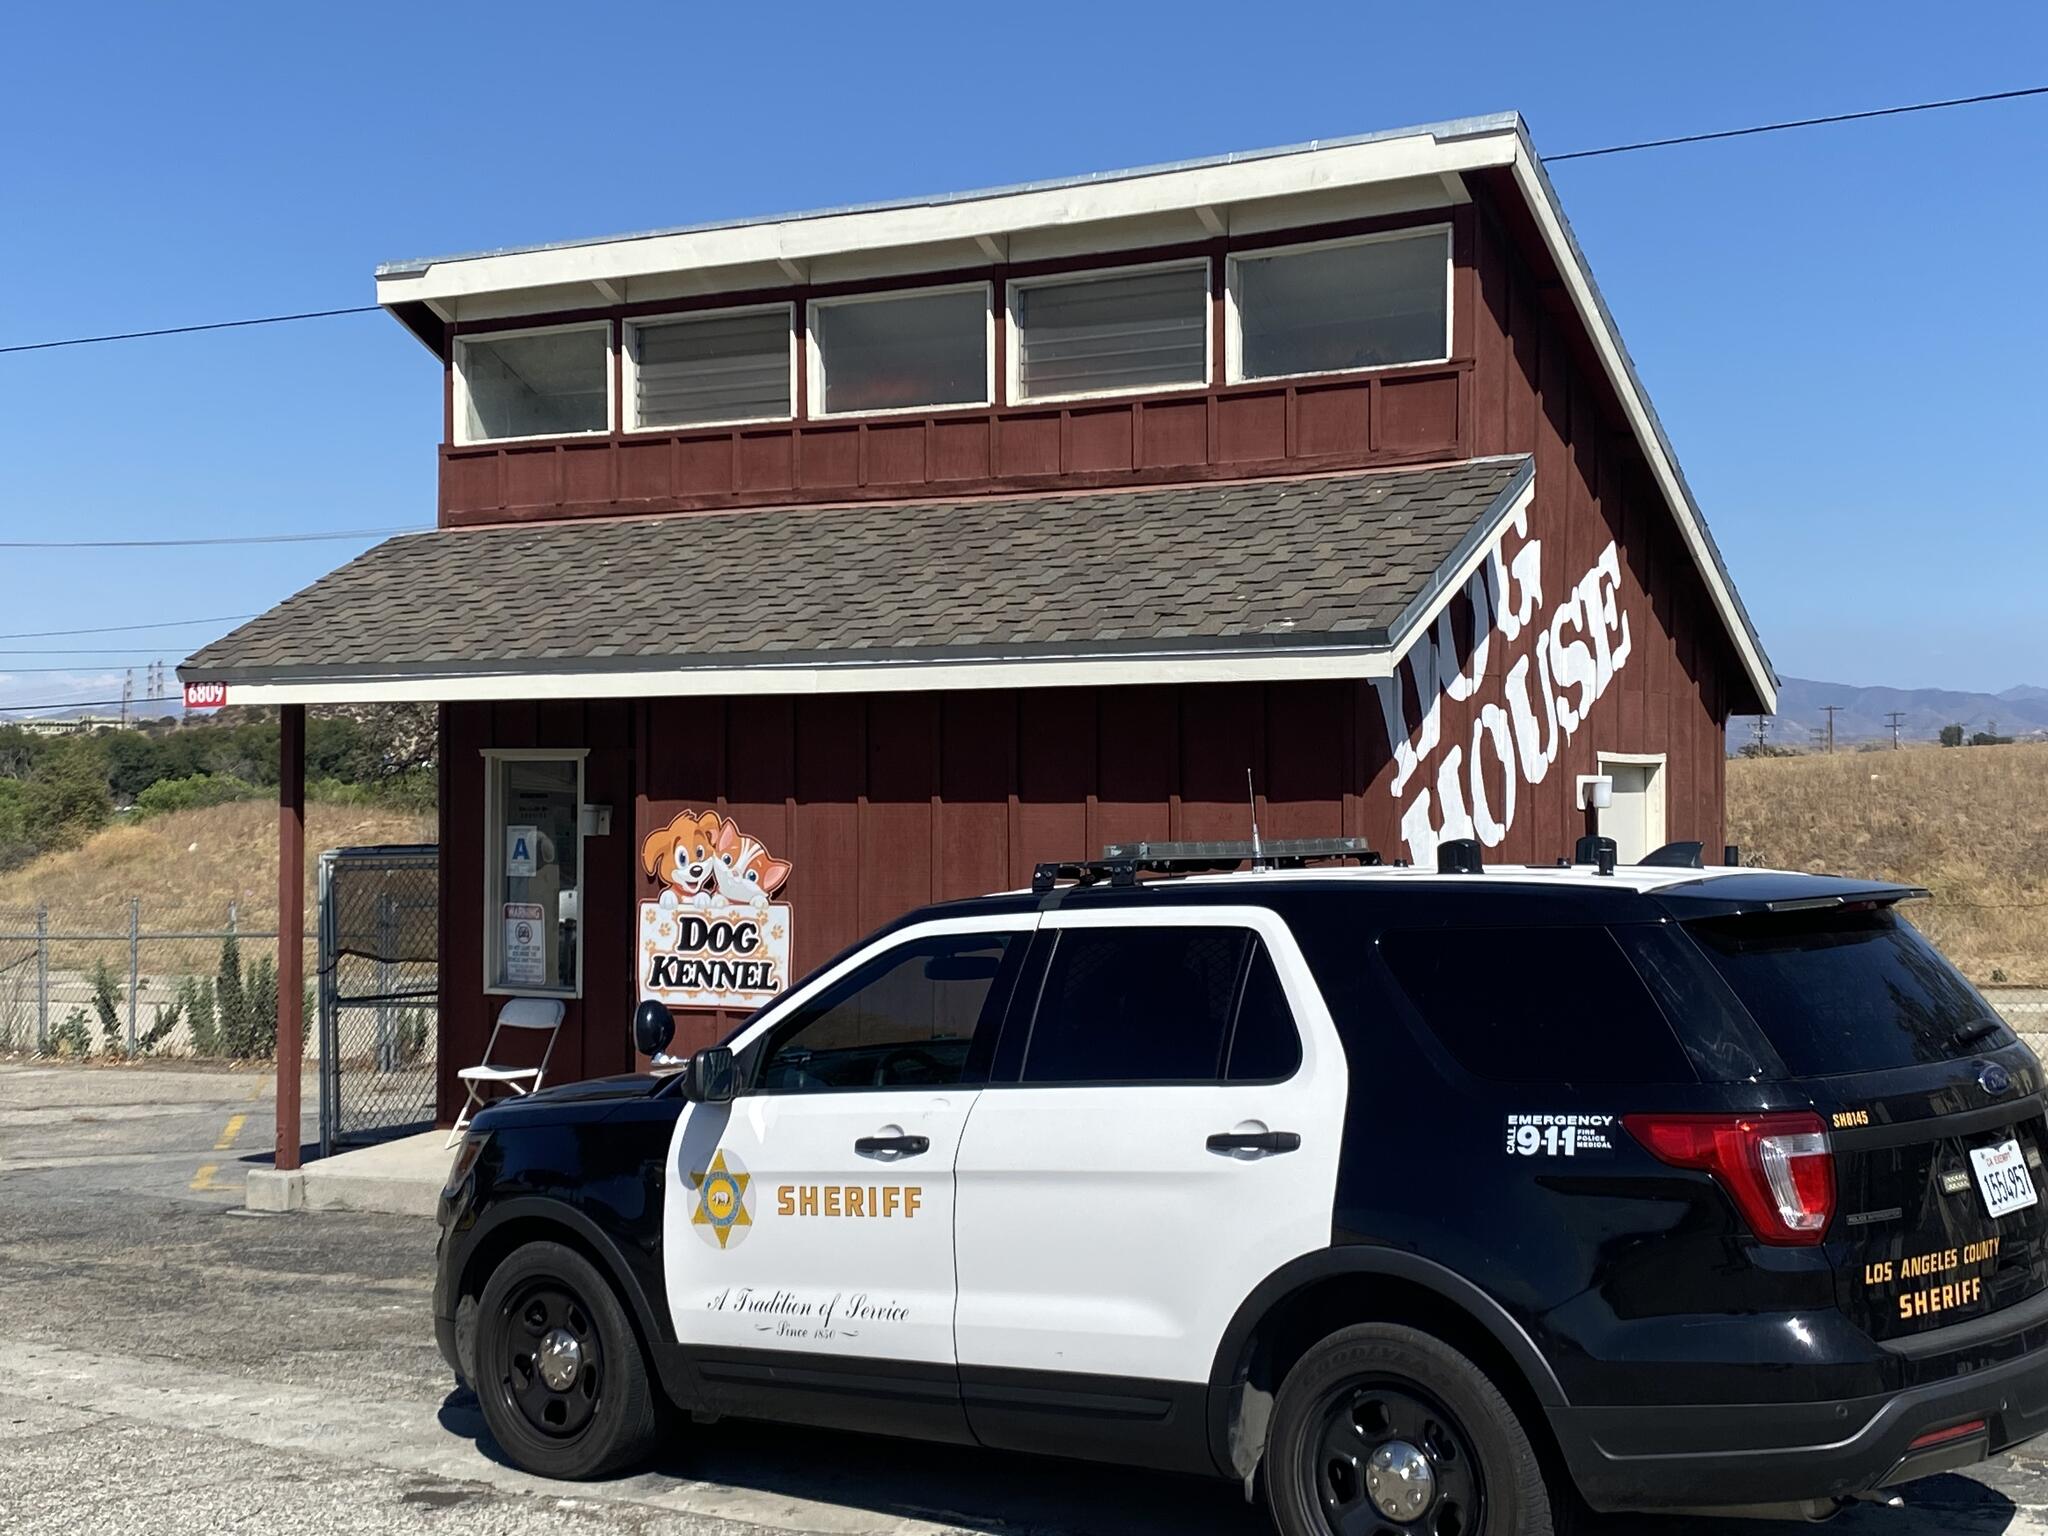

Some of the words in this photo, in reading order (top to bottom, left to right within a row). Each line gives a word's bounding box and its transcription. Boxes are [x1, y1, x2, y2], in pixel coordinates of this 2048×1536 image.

[188, 682, 224, 703] 6809
[1401, 540, 1632, 866] HOUSE
[512, 838, 530, 860] A
[676, 916, 759, 954] DOG
[648, 955, 778, 991] KENNEL
[1507, 1115, 1613, 1126] EMERGENCY
[1506, 1126, 1516, 1154] CALL
[1516, 1125, 1576, 1156] 9-1-1
[1984, 1164, 2032, 1205] 1554957
[777, 1186, 921, 1218] SHERIFF
[1865, 1261, 1893, 1284] LOS
[1901, 1249, 1958, 1279] ANGELES
[1963, 1237, 2000, 1264] COUNTY
[707, 1288, 730, 1311] A
[733, 1287, 811, 1316] Tradition
[818, 1292, 842, 1328] of
[845, 1293, 910, 1321] Service
[1900, 1277, 1981, 1319] SHERIFF
[775, 1320, 808, 1338] Since
[814, 1328, 837, 1339] 1850
